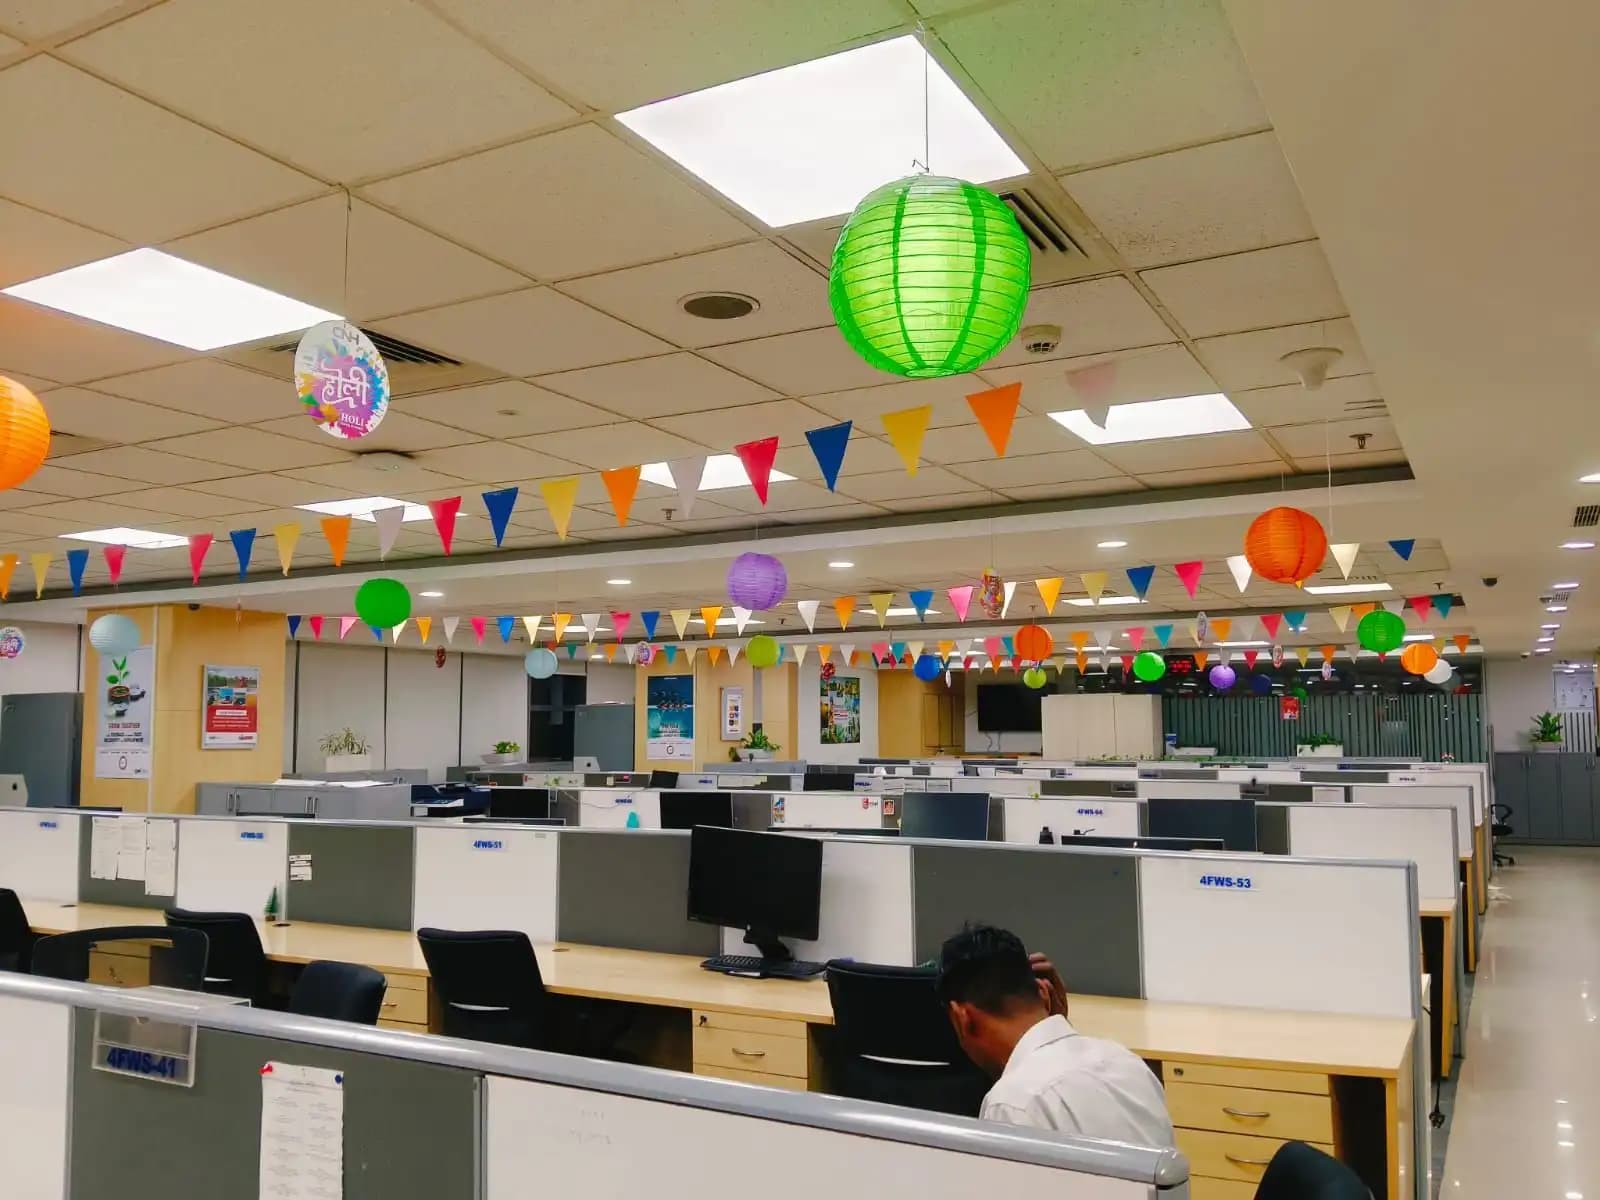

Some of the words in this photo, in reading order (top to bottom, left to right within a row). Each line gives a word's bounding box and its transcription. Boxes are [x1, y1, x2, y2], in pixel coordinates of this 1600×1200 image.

[314, 358, 370, 408] होली
[341, 412, 365, 427] HOLI
[473, 840, 502, 849] 4FWS-51
[1200, 875, 1252, 889] 4FWS-53
[106, 1046, 177, 1079] 4FWS-41
